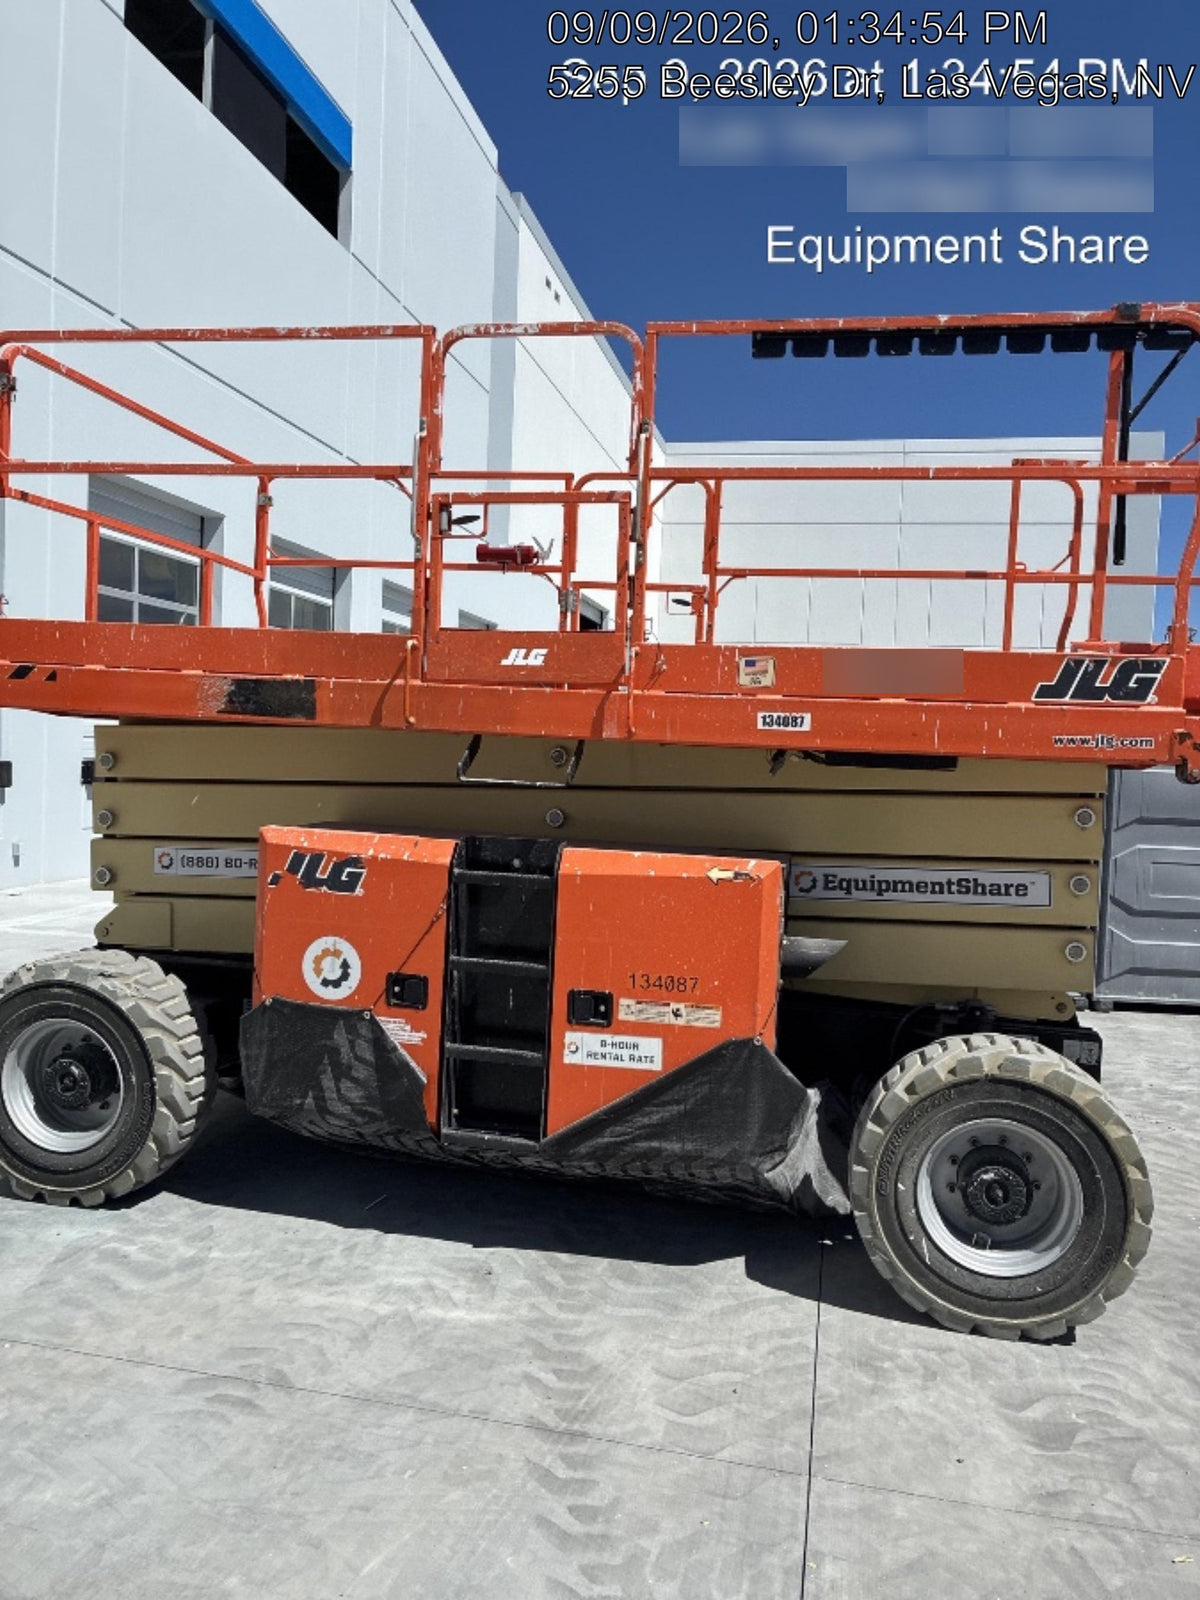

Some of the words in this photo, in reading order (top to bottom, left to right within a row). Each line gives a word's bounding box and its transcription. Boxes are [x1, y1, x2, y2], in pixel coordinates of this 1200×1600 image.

[500, 648, 549, 666] JLG
[1031, 656, 1171, 704] JLG
[761, 714, 805, 729] 134087
[1053, 734, 1154, 750] www.jlg.com
[822, 873, 1029, 897] EquipmentShare
[628, 973, 699, 993] 134087
[586, 1050, 626, 1062] RENTAL
[629, 1053, 655, 1064] RATE
